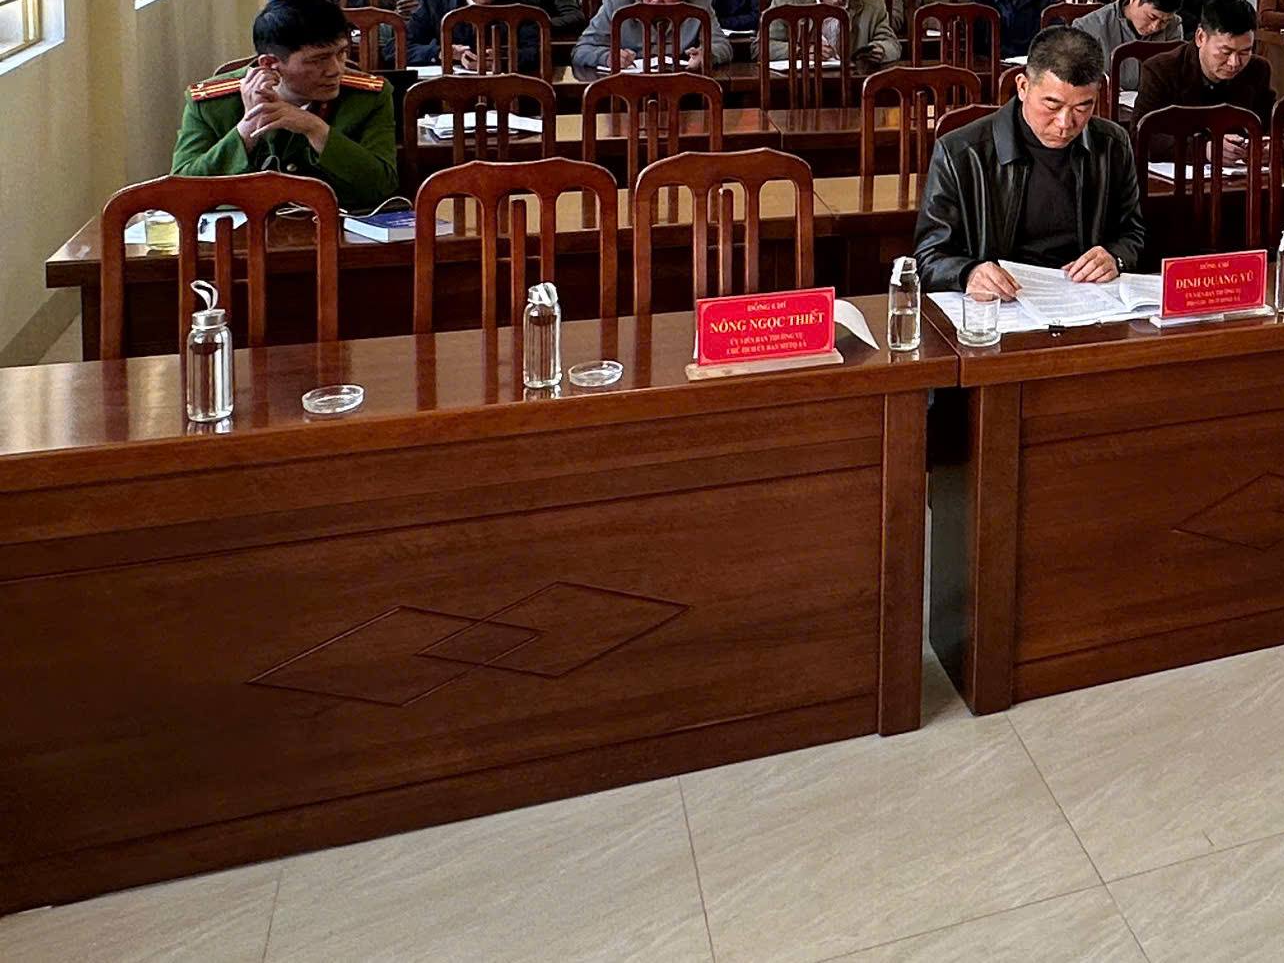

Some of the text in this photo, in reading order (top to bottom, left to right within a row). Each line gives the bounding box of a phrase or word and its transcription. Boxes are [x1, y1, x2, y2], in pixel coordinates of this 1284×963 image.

[1203, 273, 1238, 287] QUANG
[709, 308, 825, 334] NÔNG NGỌC THIẾT
